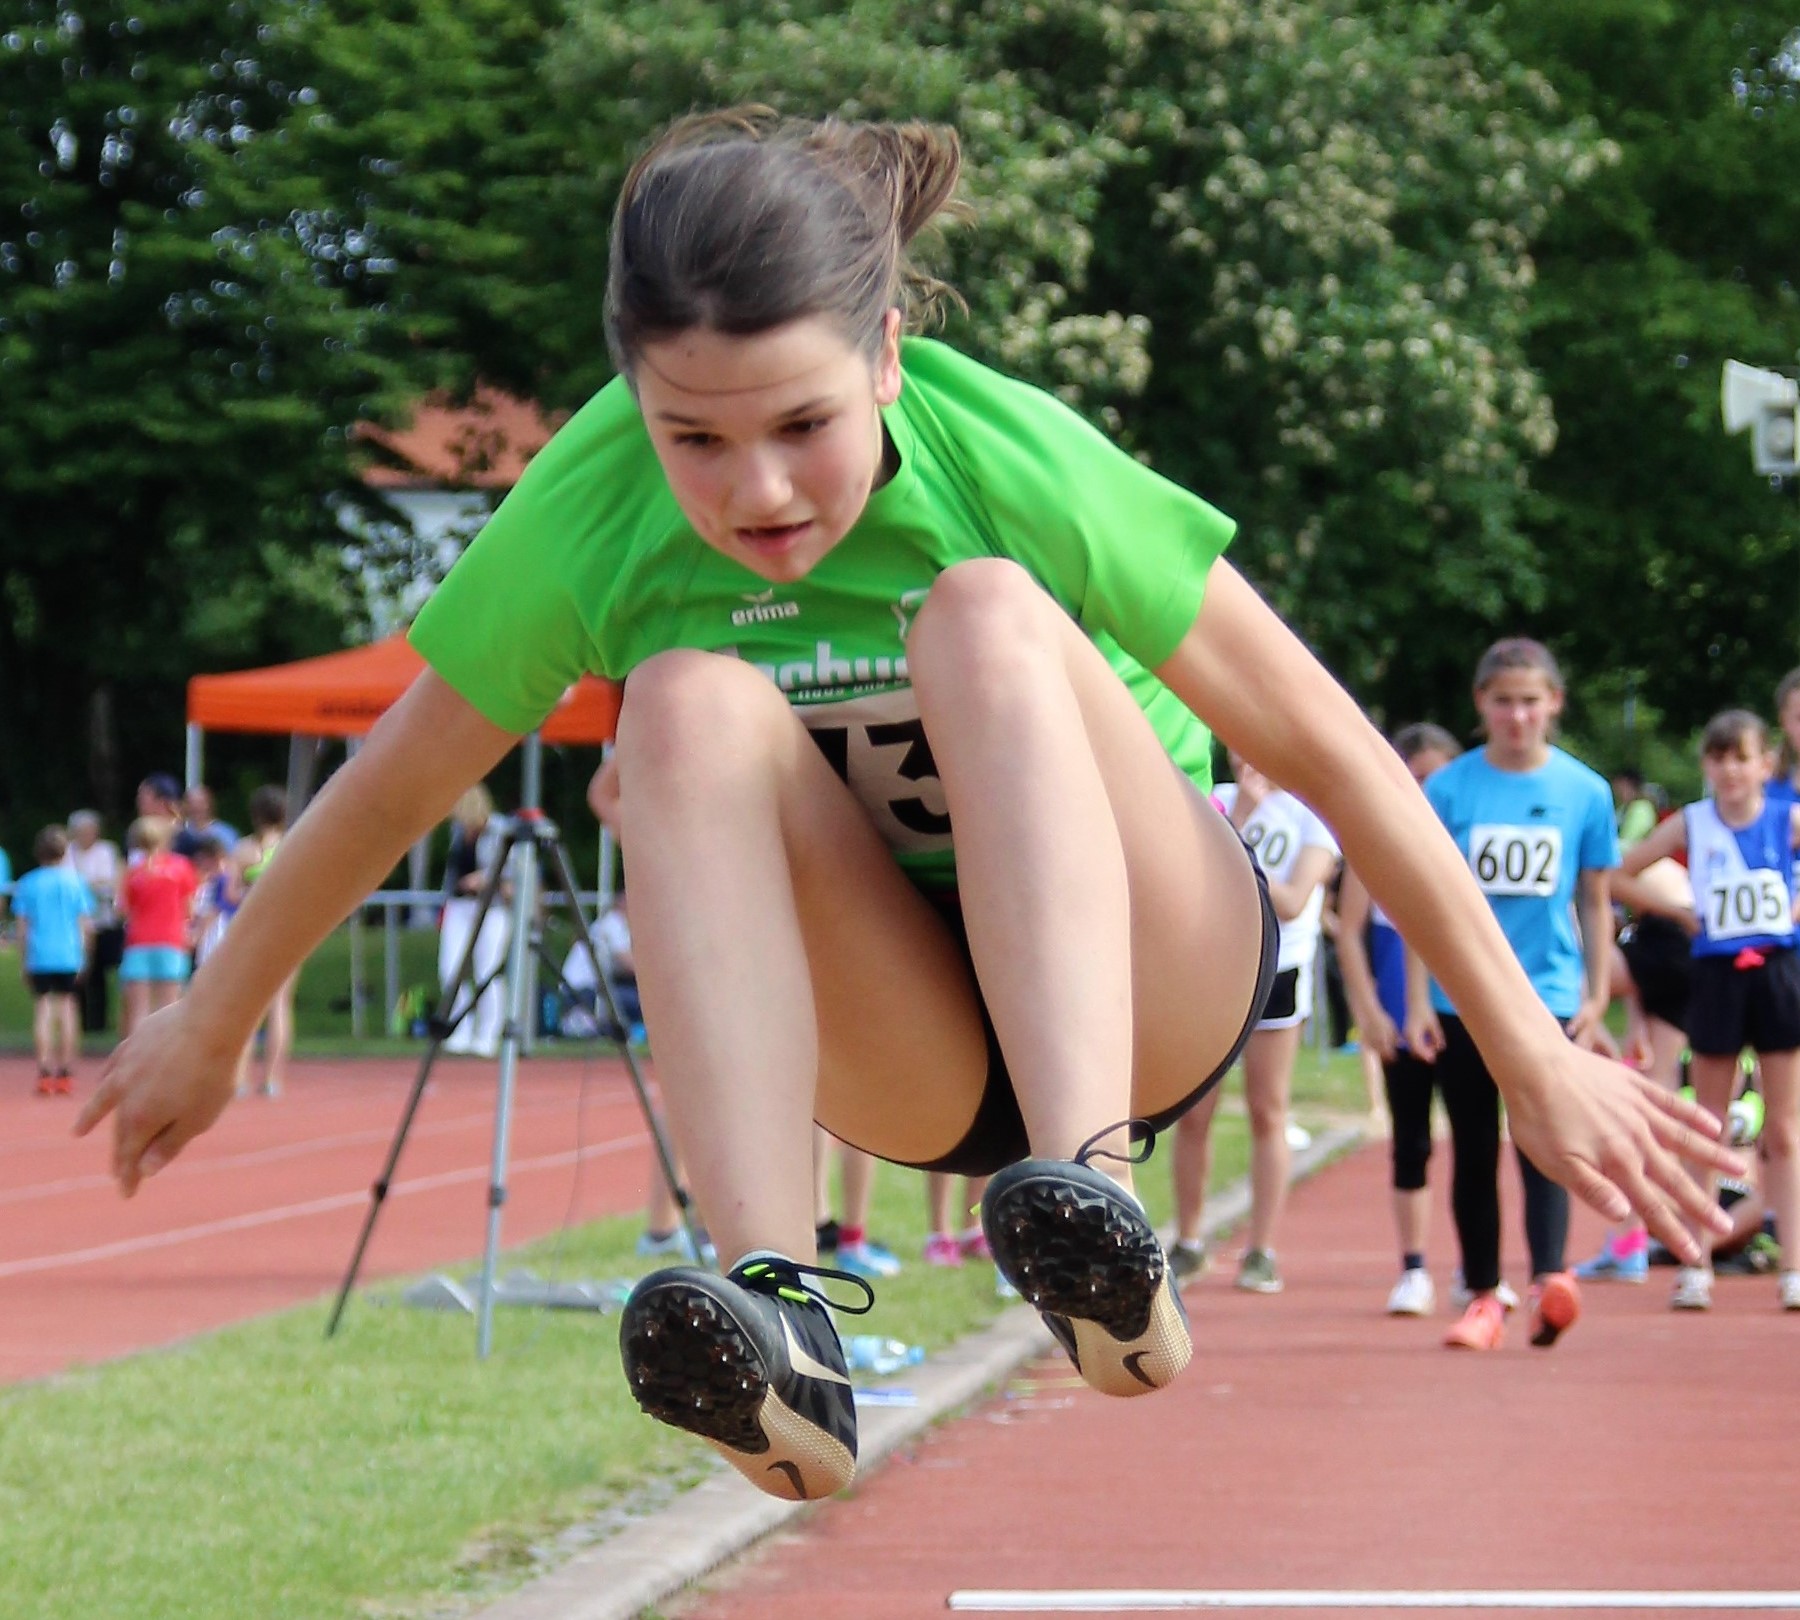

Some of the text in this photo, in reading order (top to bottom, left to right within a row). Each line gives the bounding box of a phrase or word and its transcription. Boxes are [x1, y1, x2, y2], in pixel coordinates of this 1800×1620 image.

[731, 601, 799, 627] erima
[1477, 837, 1552, 882] 602
[1713, 882, 1782, 927] 705
